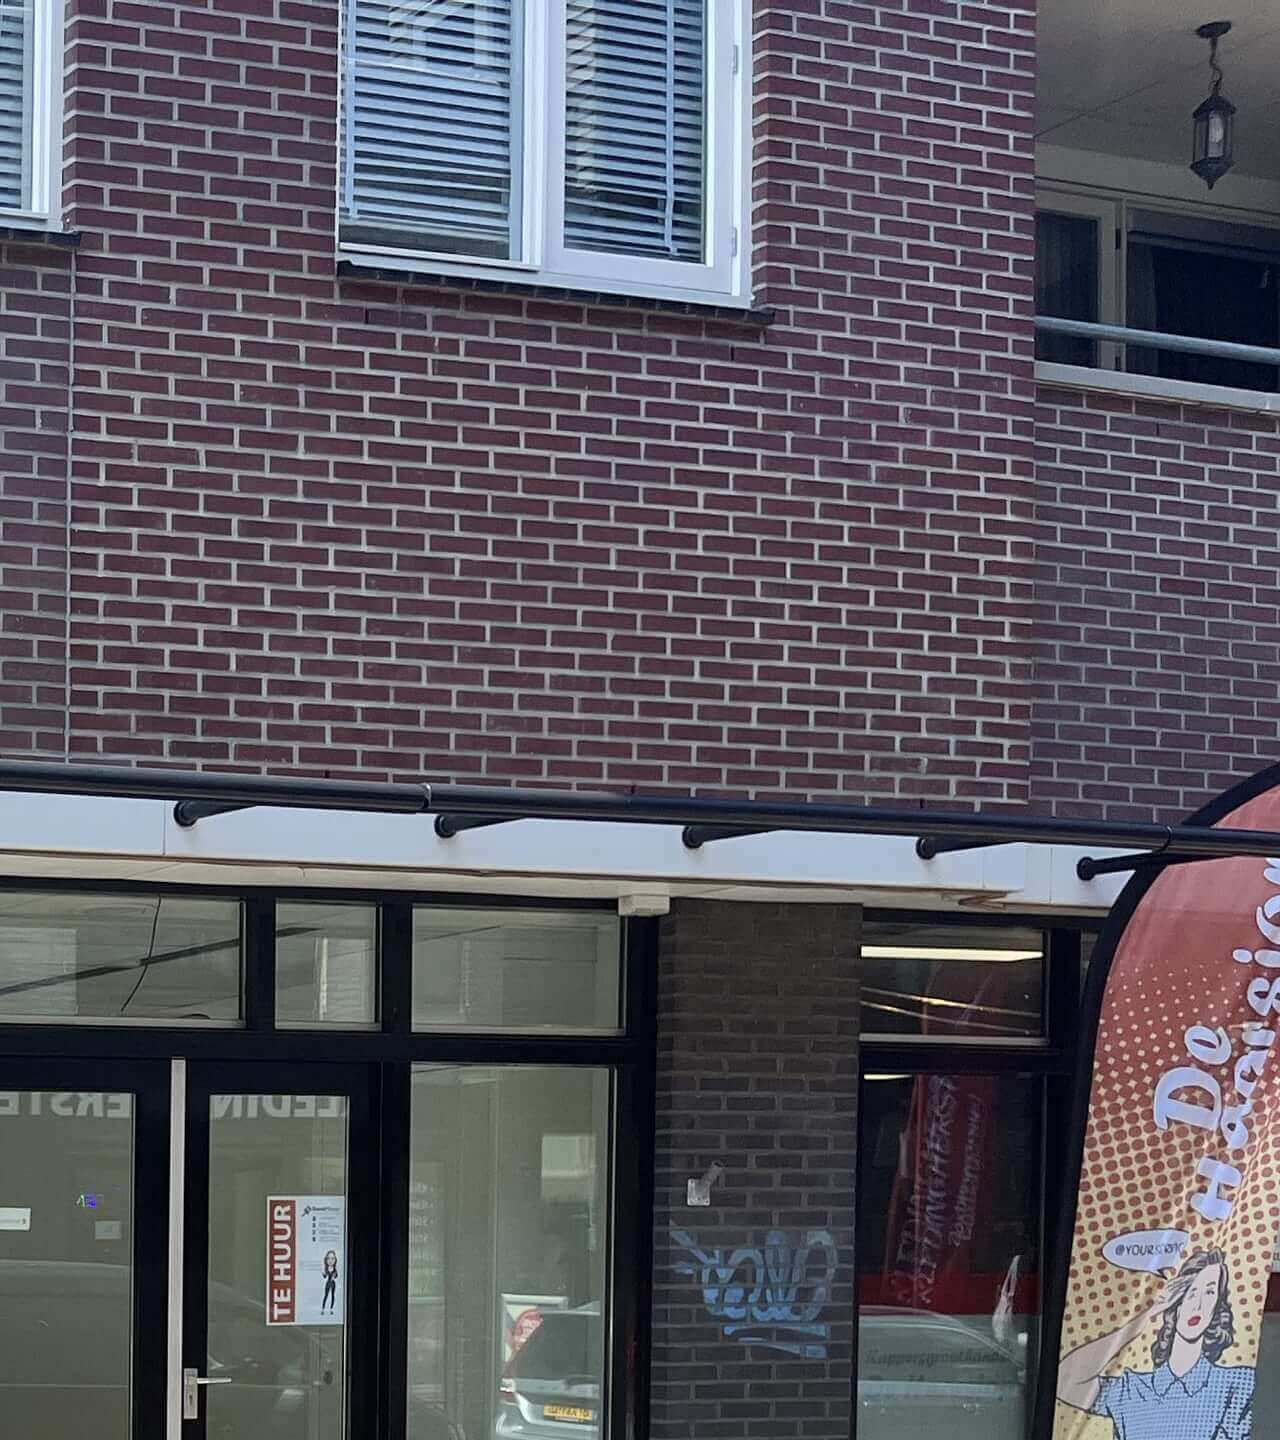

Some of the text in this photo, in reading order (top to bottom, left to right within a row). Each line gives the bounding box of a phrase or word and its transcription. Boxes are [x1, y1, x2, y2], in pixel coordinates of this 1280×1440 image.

[1153, 1025, 1233, 1132] De
[273, 1204, 292, 1321] TE HUUR
